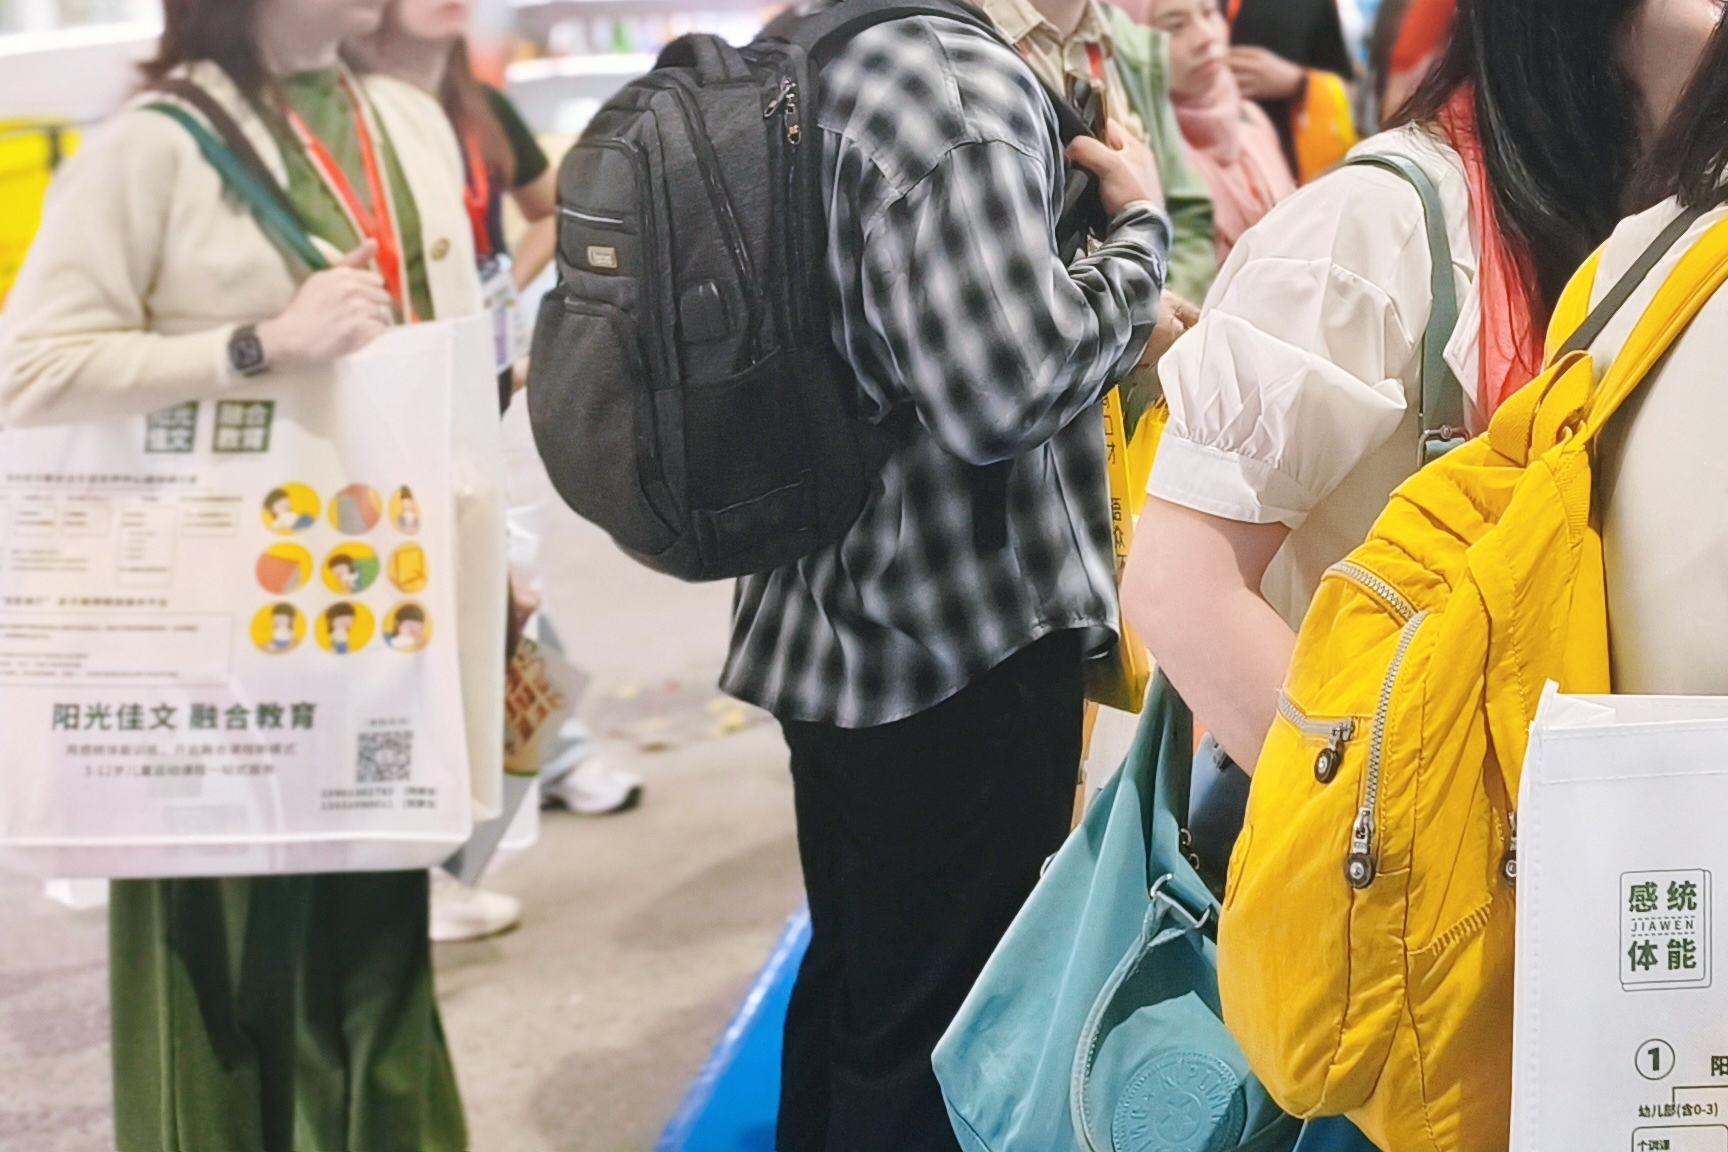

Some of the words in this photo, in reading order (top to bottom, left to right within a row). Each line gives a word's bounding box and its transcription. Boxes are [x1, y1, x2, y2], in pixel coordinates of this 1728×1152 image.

[52, 703, 178, 731] 阳光佳文
[189, 702, 317, 730] 融合教育
[1628, 880, 1697, 913] 感统
[1630, 919, 1695, 932] JIAWEN
[1627, 937, 1698, 972] 体能
